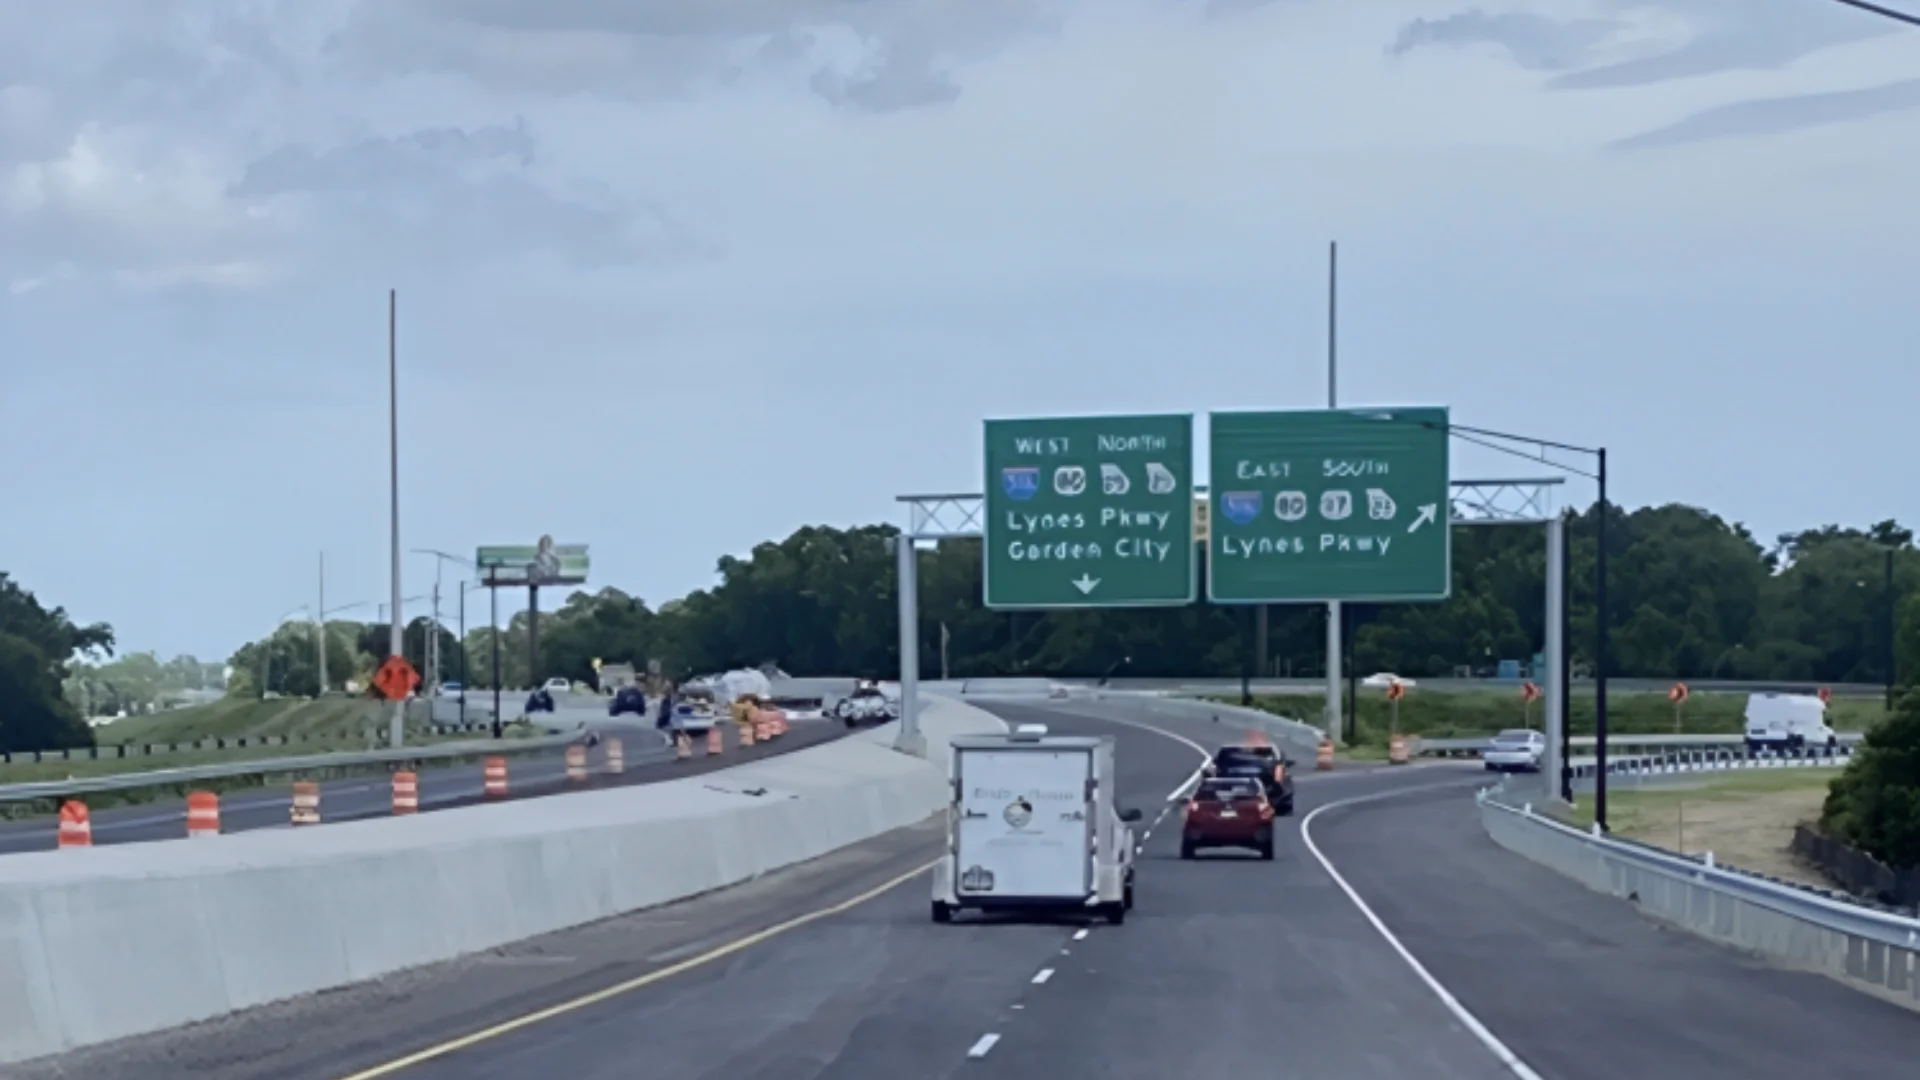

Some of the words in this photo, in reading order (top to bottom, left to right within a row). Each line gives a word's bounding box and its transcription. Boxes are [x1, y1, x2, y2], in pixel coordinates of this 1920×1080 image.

[1015, 437, 1069, 454] WEST
[1098, 434, 1166, 451] NORTH
[1237, 460, 1290, 479] EAST
[1323, 458, 1389, 477] SOUTH
[1007, 511, 1085, 533] Lynes
[1101, 507, 1170, 530] Pkwy
[1008, 540, 1101, 560] Garden
[1115, 537, 1170, 561] City
[1223, 535, 1304, 558] Lynes
[1320, 534, 1391, 555] Pkwy
